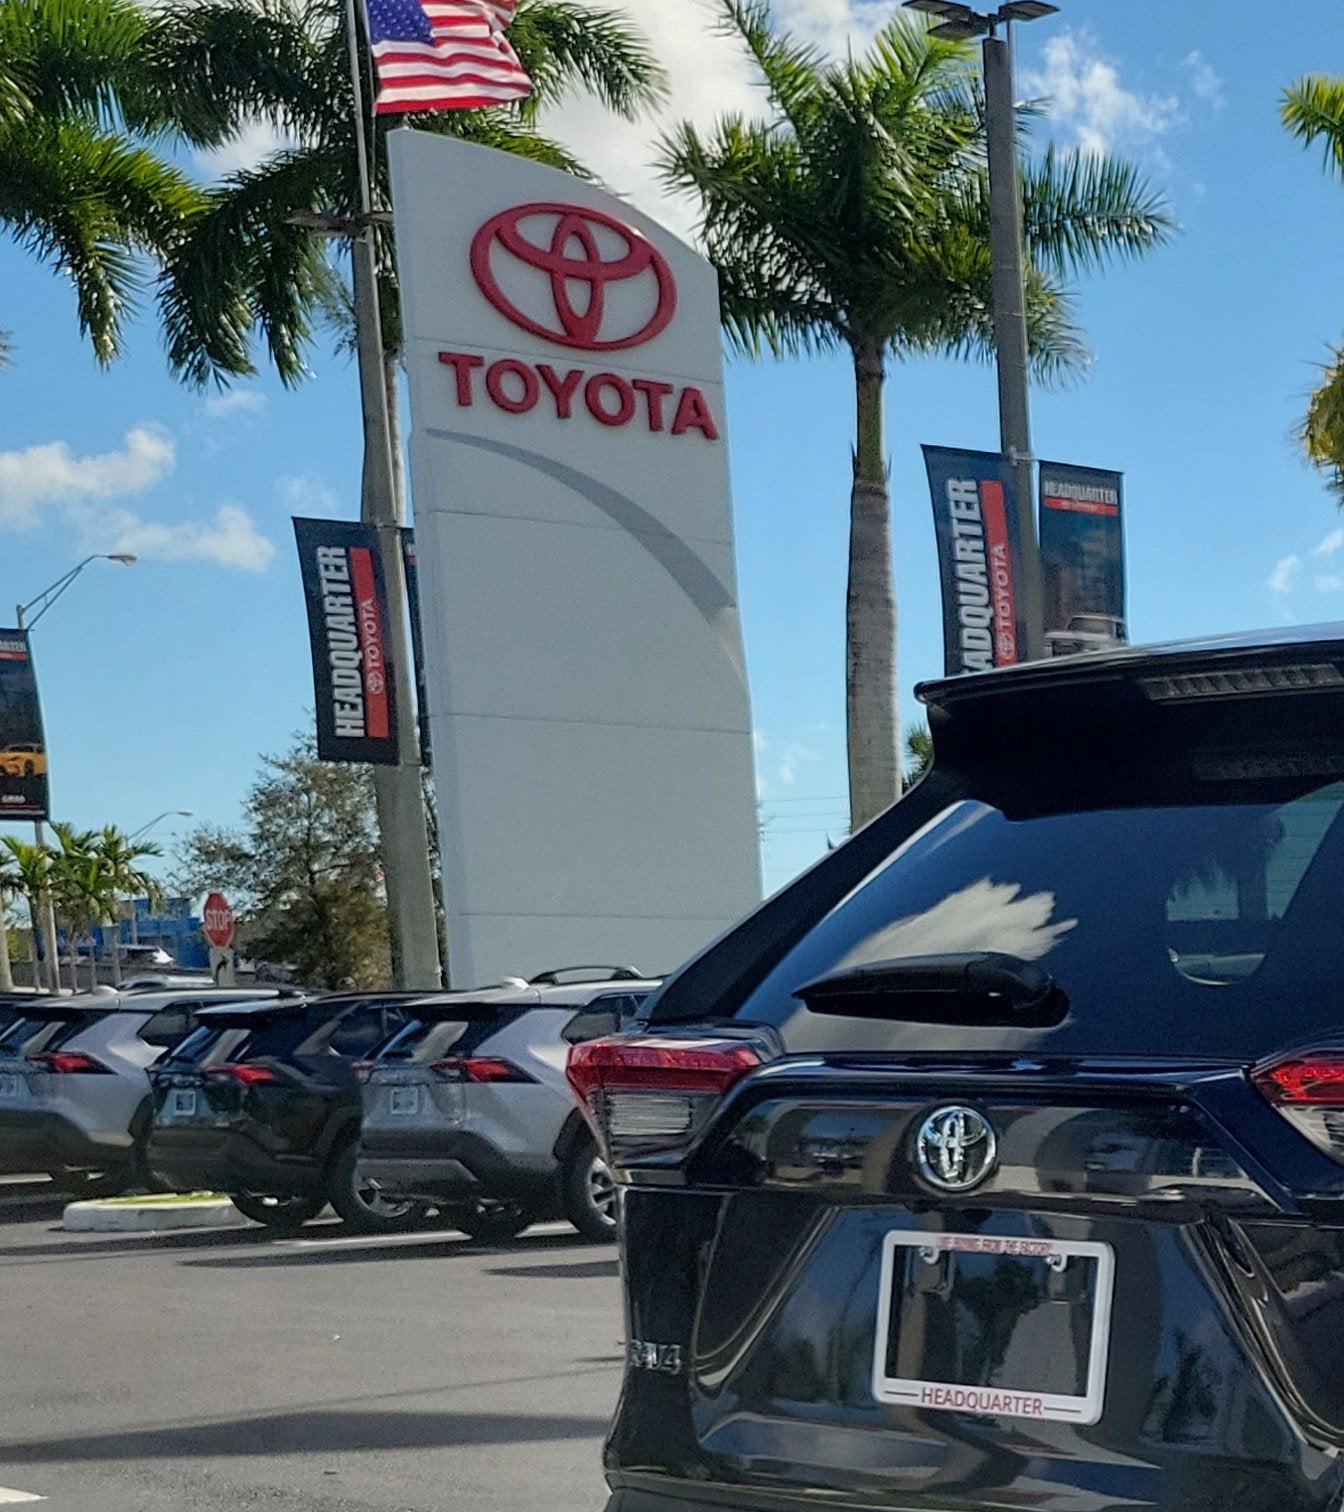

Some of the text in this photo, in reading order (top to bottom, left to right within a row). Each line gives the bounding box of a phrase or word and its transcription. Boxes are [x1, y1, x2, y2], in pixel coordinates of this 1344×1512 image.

[438, 352, 720, 442] TOYOTA
[946, 476, 996, 674] ADQUARTER
[990, 544, 1014, 630] TOYOTA
[316, 545, 366, 738] HEADQUARTER
[360, 598, 382, 666] TOYOTA
[205, 908, 232, 931] STOP
[922, 1387, 1042, 1415] HEADQUARTER
